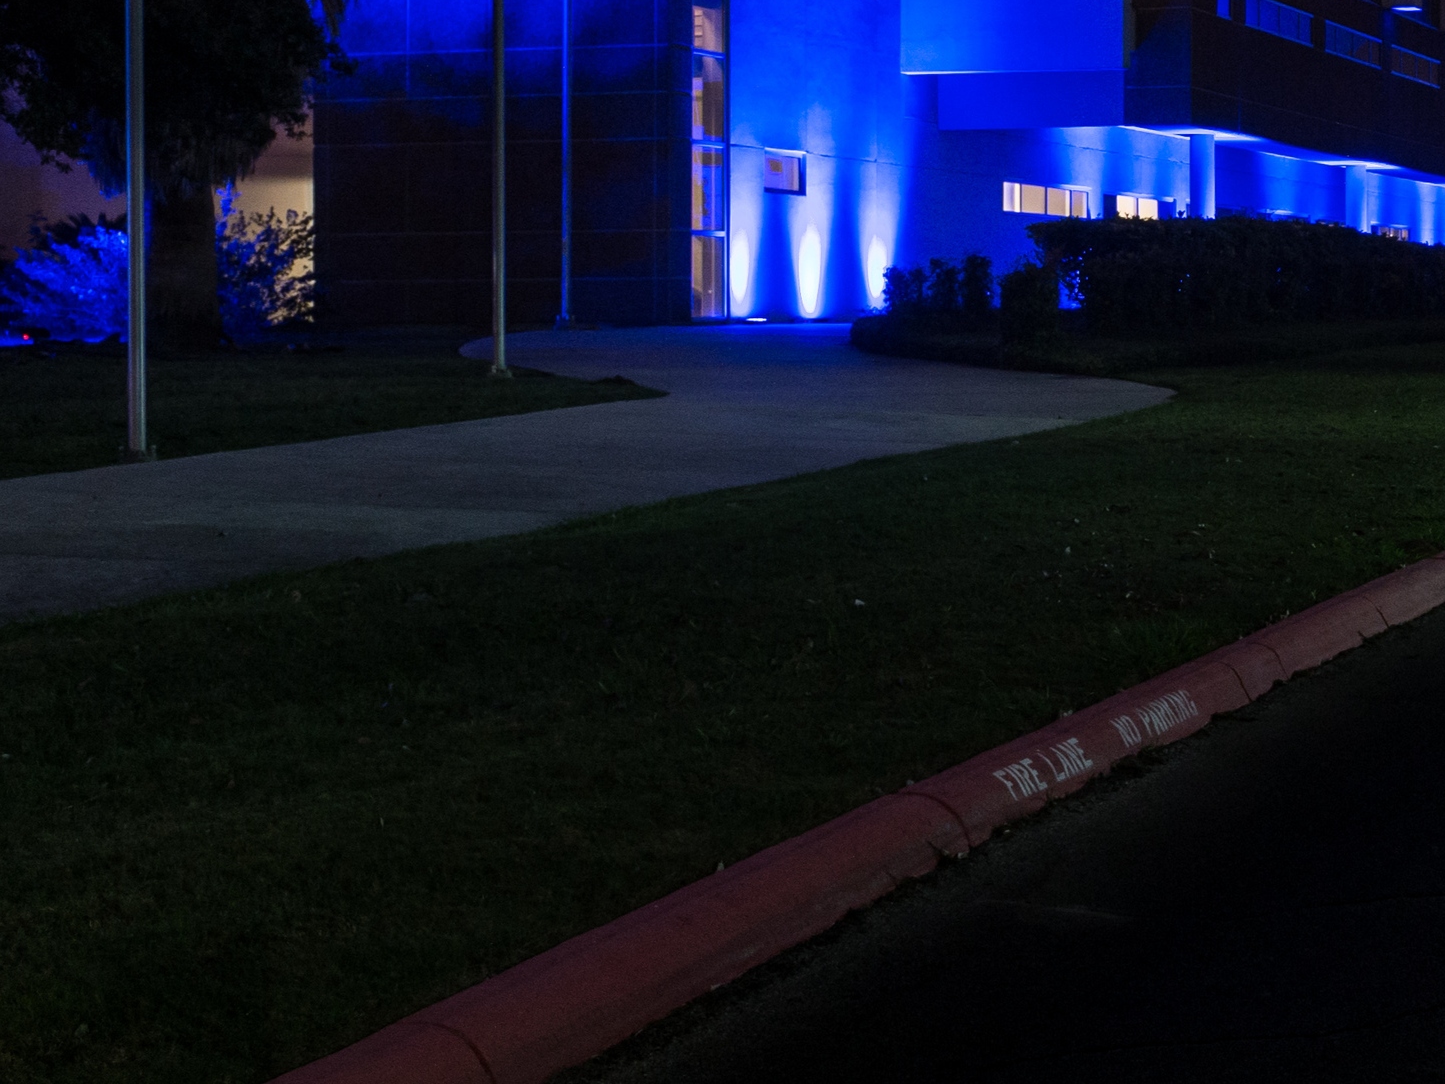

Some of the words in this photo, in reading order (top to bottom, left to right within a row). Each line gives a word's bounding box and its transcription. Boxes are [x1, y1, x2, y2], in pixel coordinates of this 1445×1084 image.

[993, 758, 1048, 802] FIRE
[1036, 737, 1093, 783] LANE
[1109, 715, 1142, 748] NO
[1136, 689, 1199, 737] PARKING
